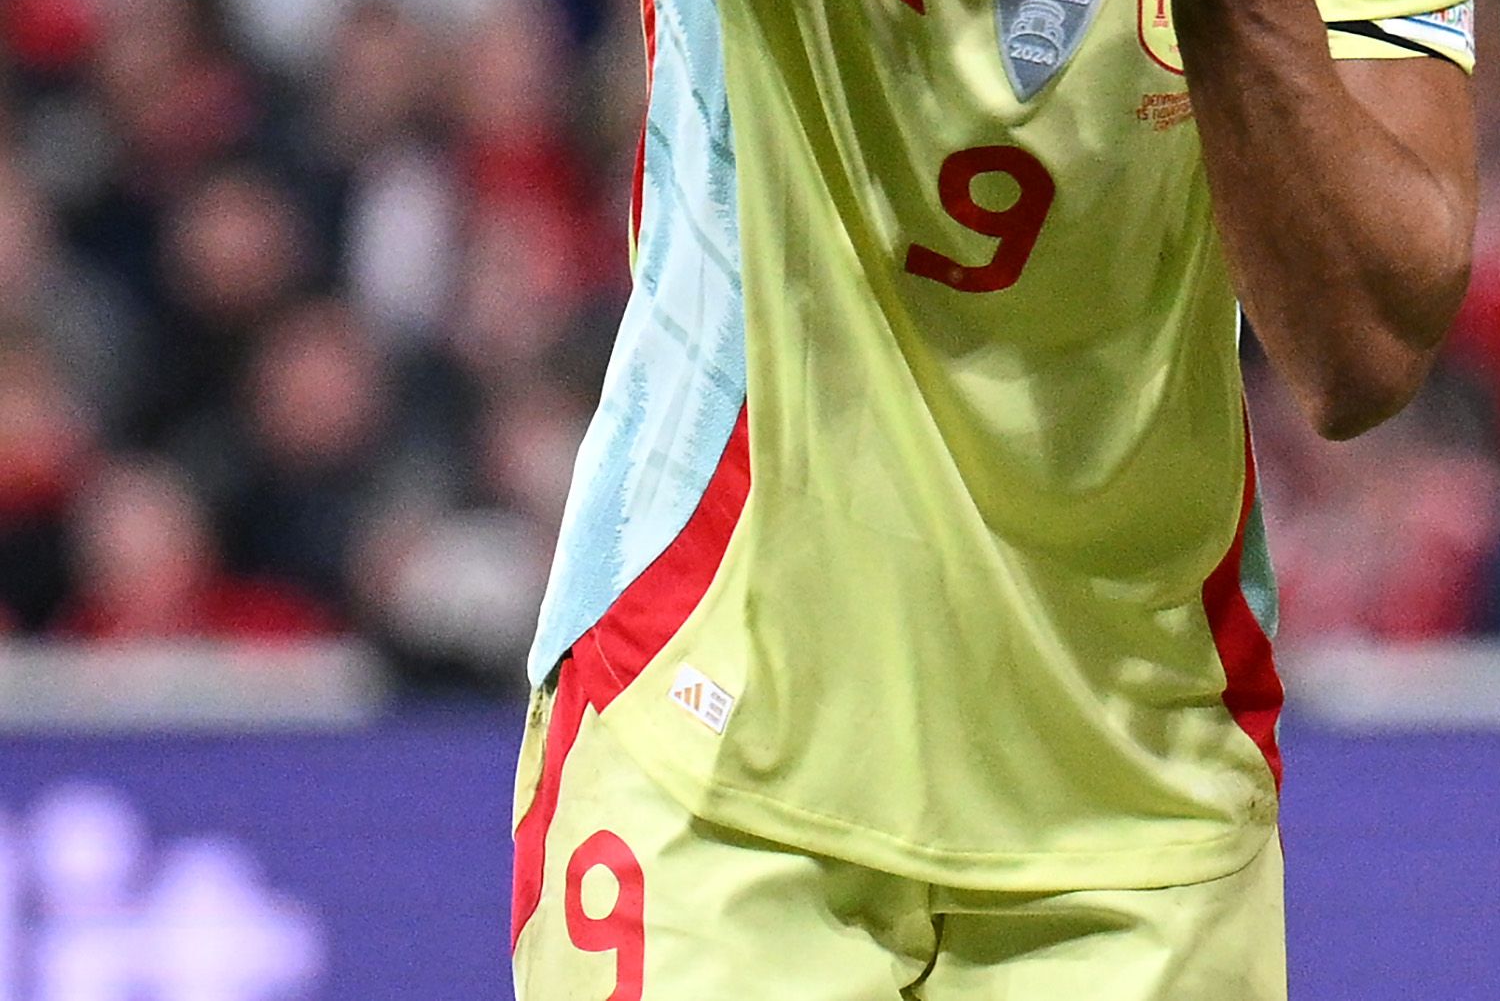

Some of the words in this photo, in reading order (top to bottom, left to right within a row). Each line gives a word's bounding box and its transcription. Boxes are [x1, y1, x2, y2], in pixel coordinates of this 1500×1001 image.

[1009, 42, 1055, 66] 2024
[904, 144, 1057, 294] 9
[564, 829, 645, 1001] 9
